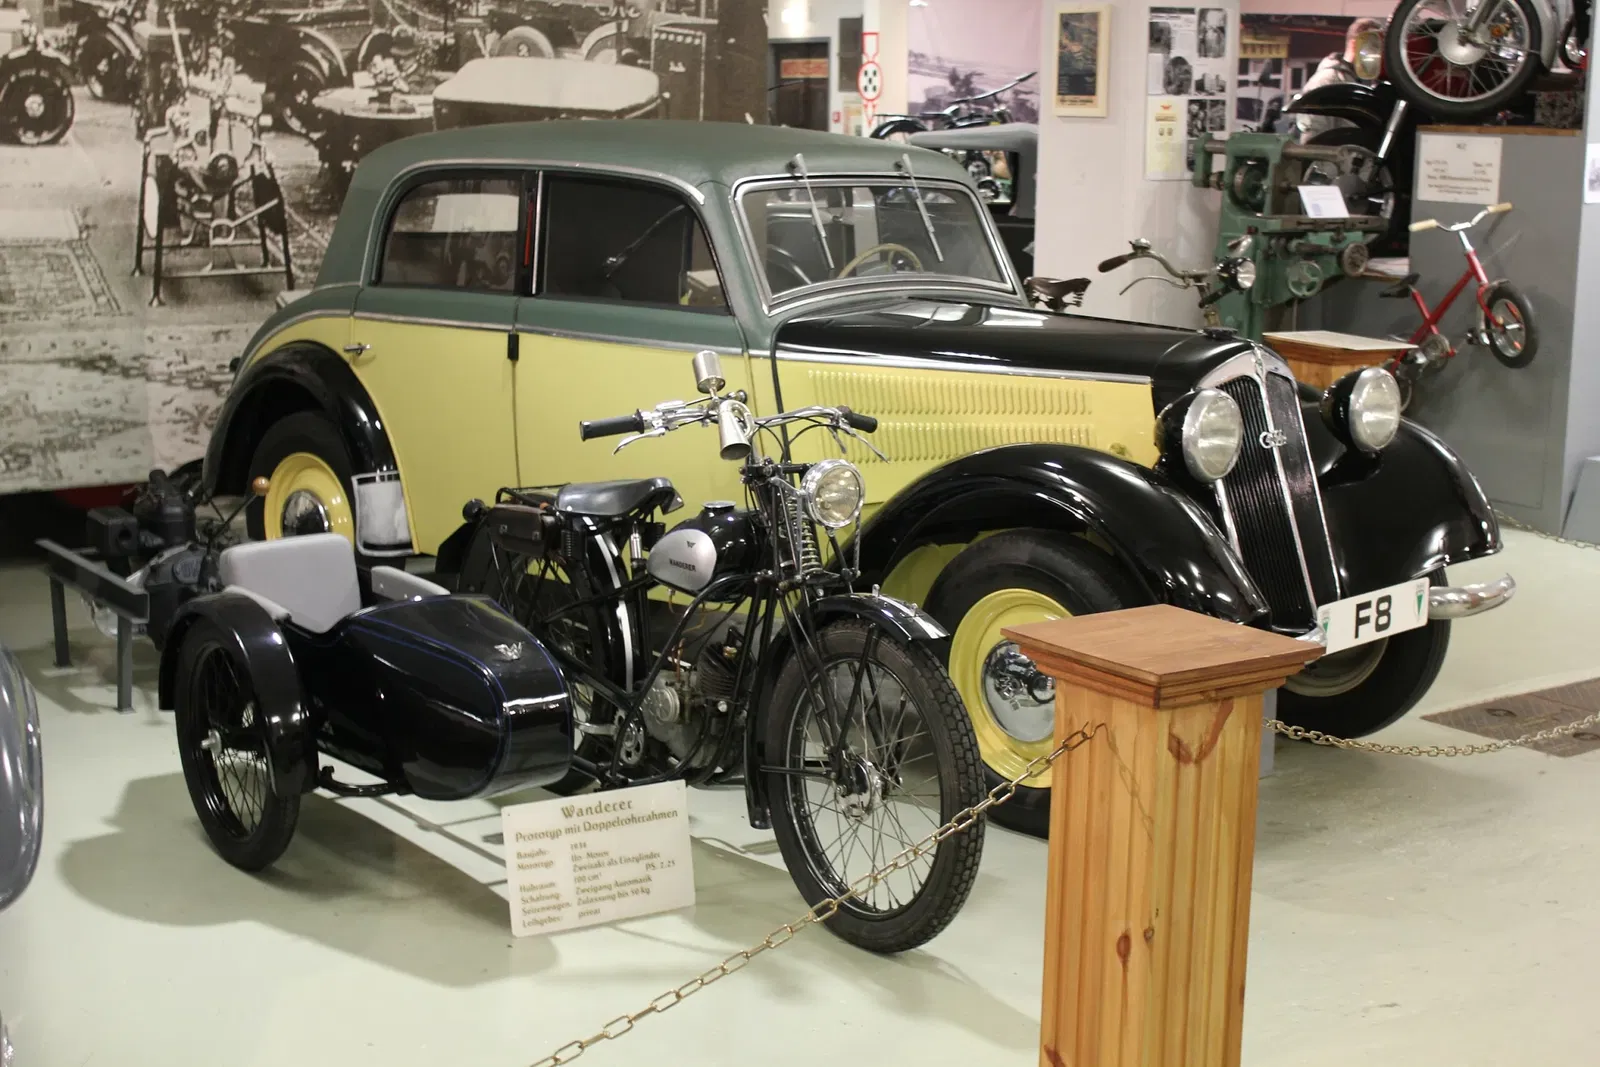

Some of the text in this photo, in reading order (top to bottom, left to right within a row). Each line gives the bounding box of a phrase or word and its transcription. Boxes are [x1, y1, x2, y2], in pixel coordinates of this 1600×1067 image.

[669, 558, 697, 573] WANDERER
[1354, 594, 1392, 640] F8
[560, 800, 632, 818] Wanderer
[515, 808, 678, 843] Prototyp mit Doppelrohrrahmen
